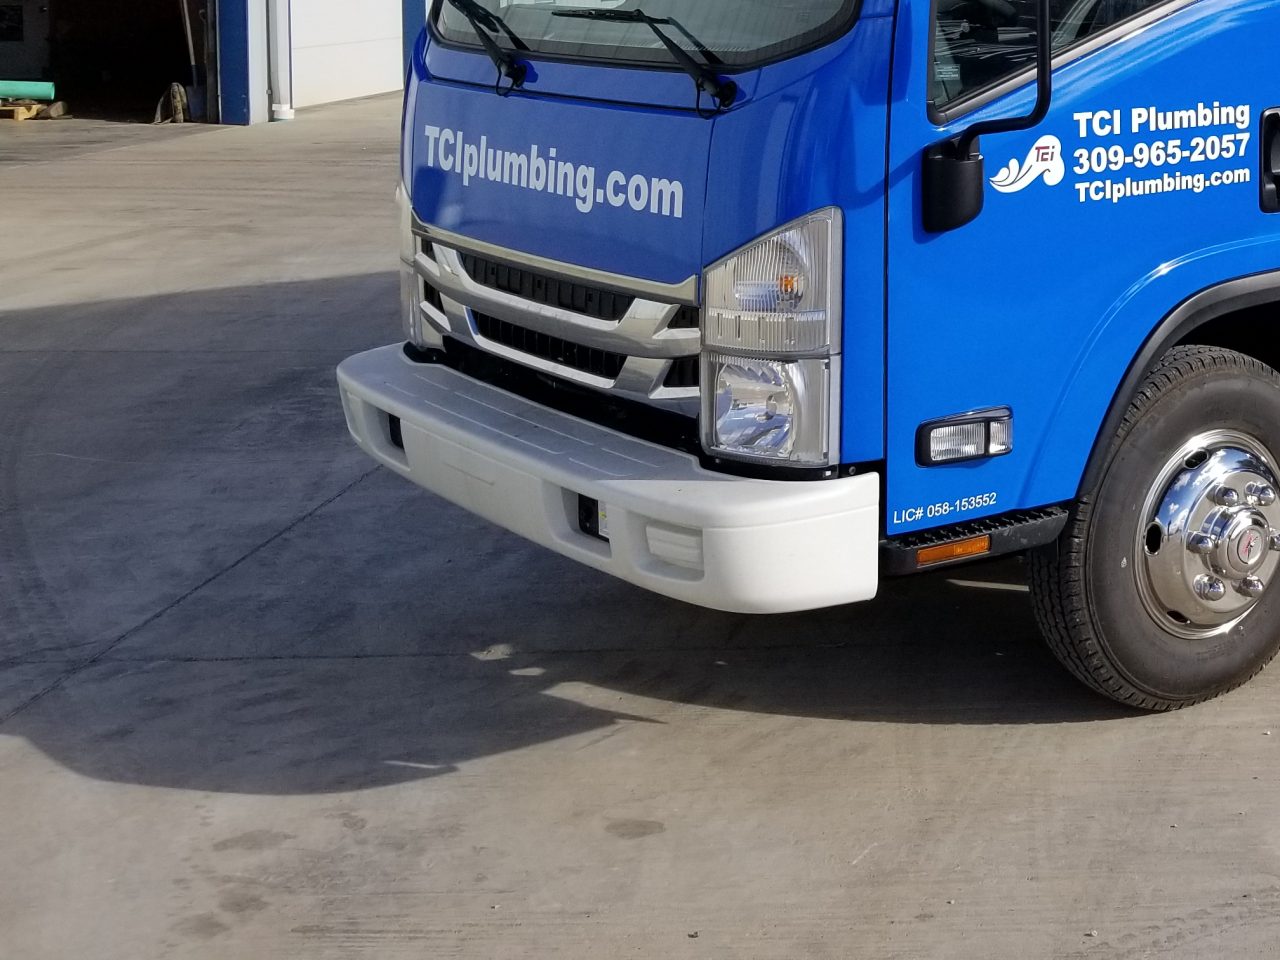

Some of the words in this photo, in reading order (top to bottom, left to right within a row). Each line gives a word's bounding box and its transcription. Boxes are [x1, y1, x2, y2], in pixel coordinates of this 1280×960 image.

[1073, 109, 1121, 138] TCI
[1131, 102, 1250, 133] Plumbing
[425, 125, 683, 218] TCIplumbing.com
[1073, 133, 1250, 174] 309-965-2057
[1075, 168, 1250, 203] TCIplumbing.com
[893, 507, 923, 524] LIC#
[927, 492, 997, 517] 058-153552
